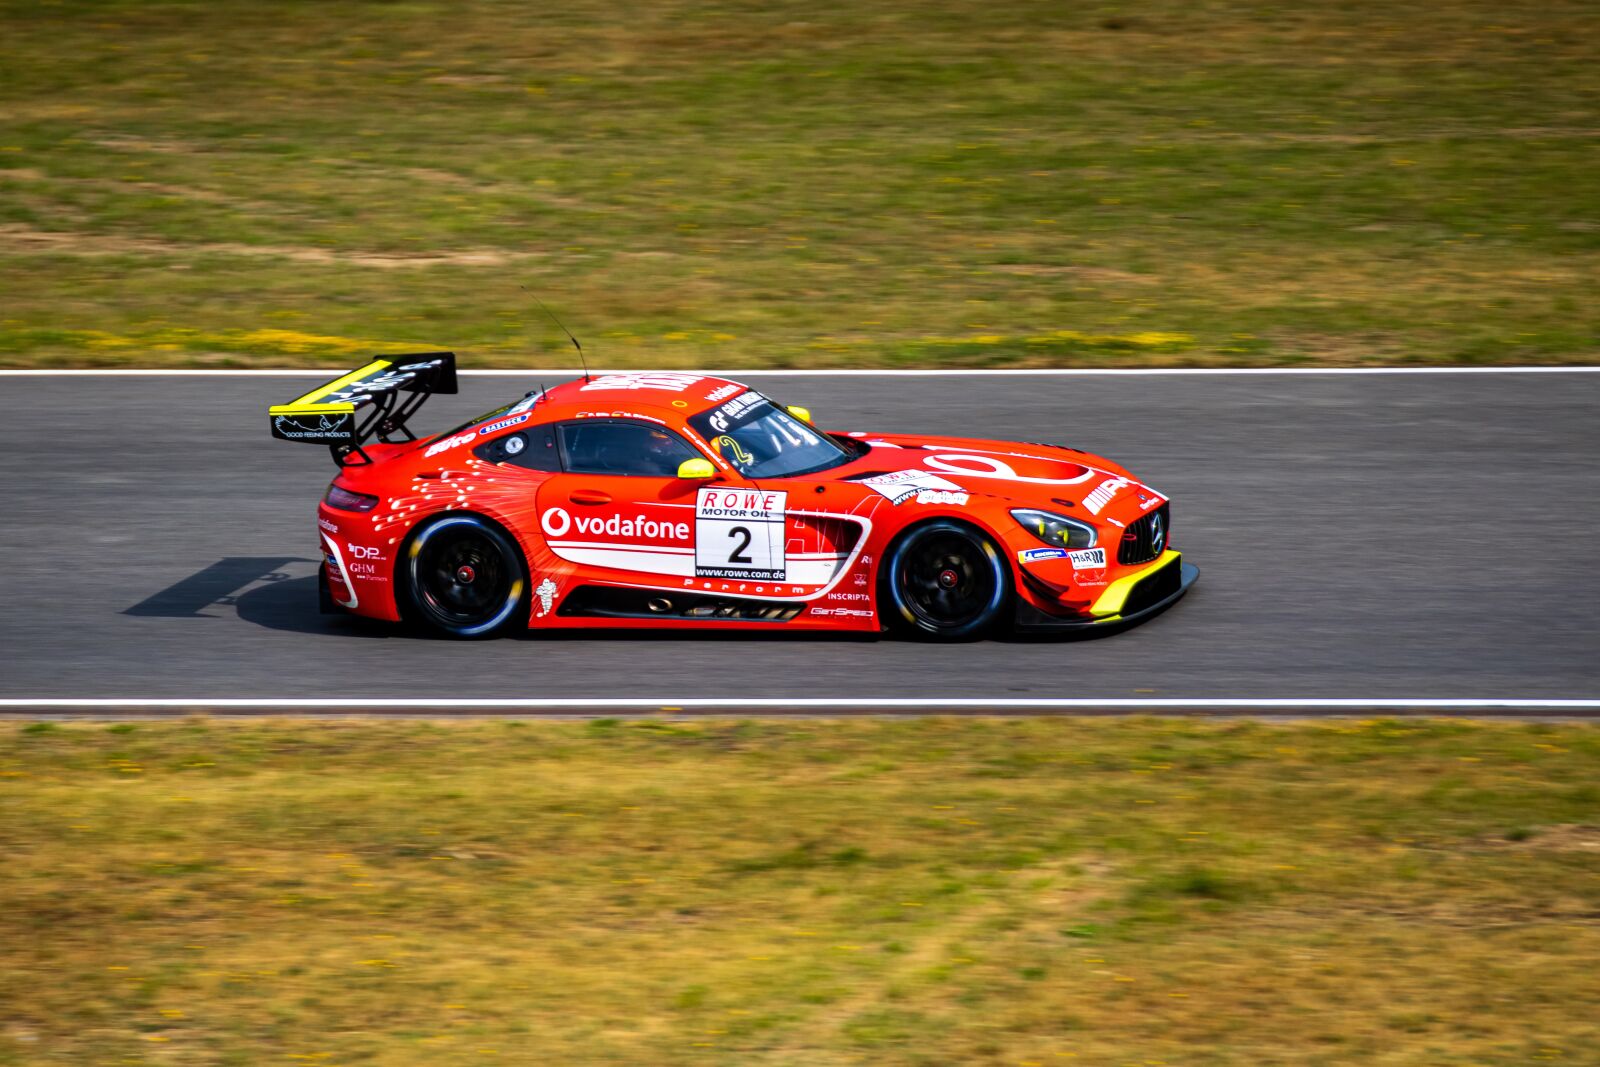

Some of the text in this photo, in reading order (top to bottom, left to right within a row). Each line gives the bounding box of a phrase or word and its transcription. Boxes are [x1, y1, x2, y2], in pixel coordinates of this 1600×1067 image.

[719, 435, 751, 463] 2
[704, 492, 776, 510] ROWE
[701, 508, 747, 517] MOTOR
[574, 514, 690, 540] vodafone
[728, 526, 753, 564] 2
[349, 562, 375, 574] GHM
[696, 567, 785, 580] www.rowe.com.de
[827, 592, 870, 602] INSCRIPTA
